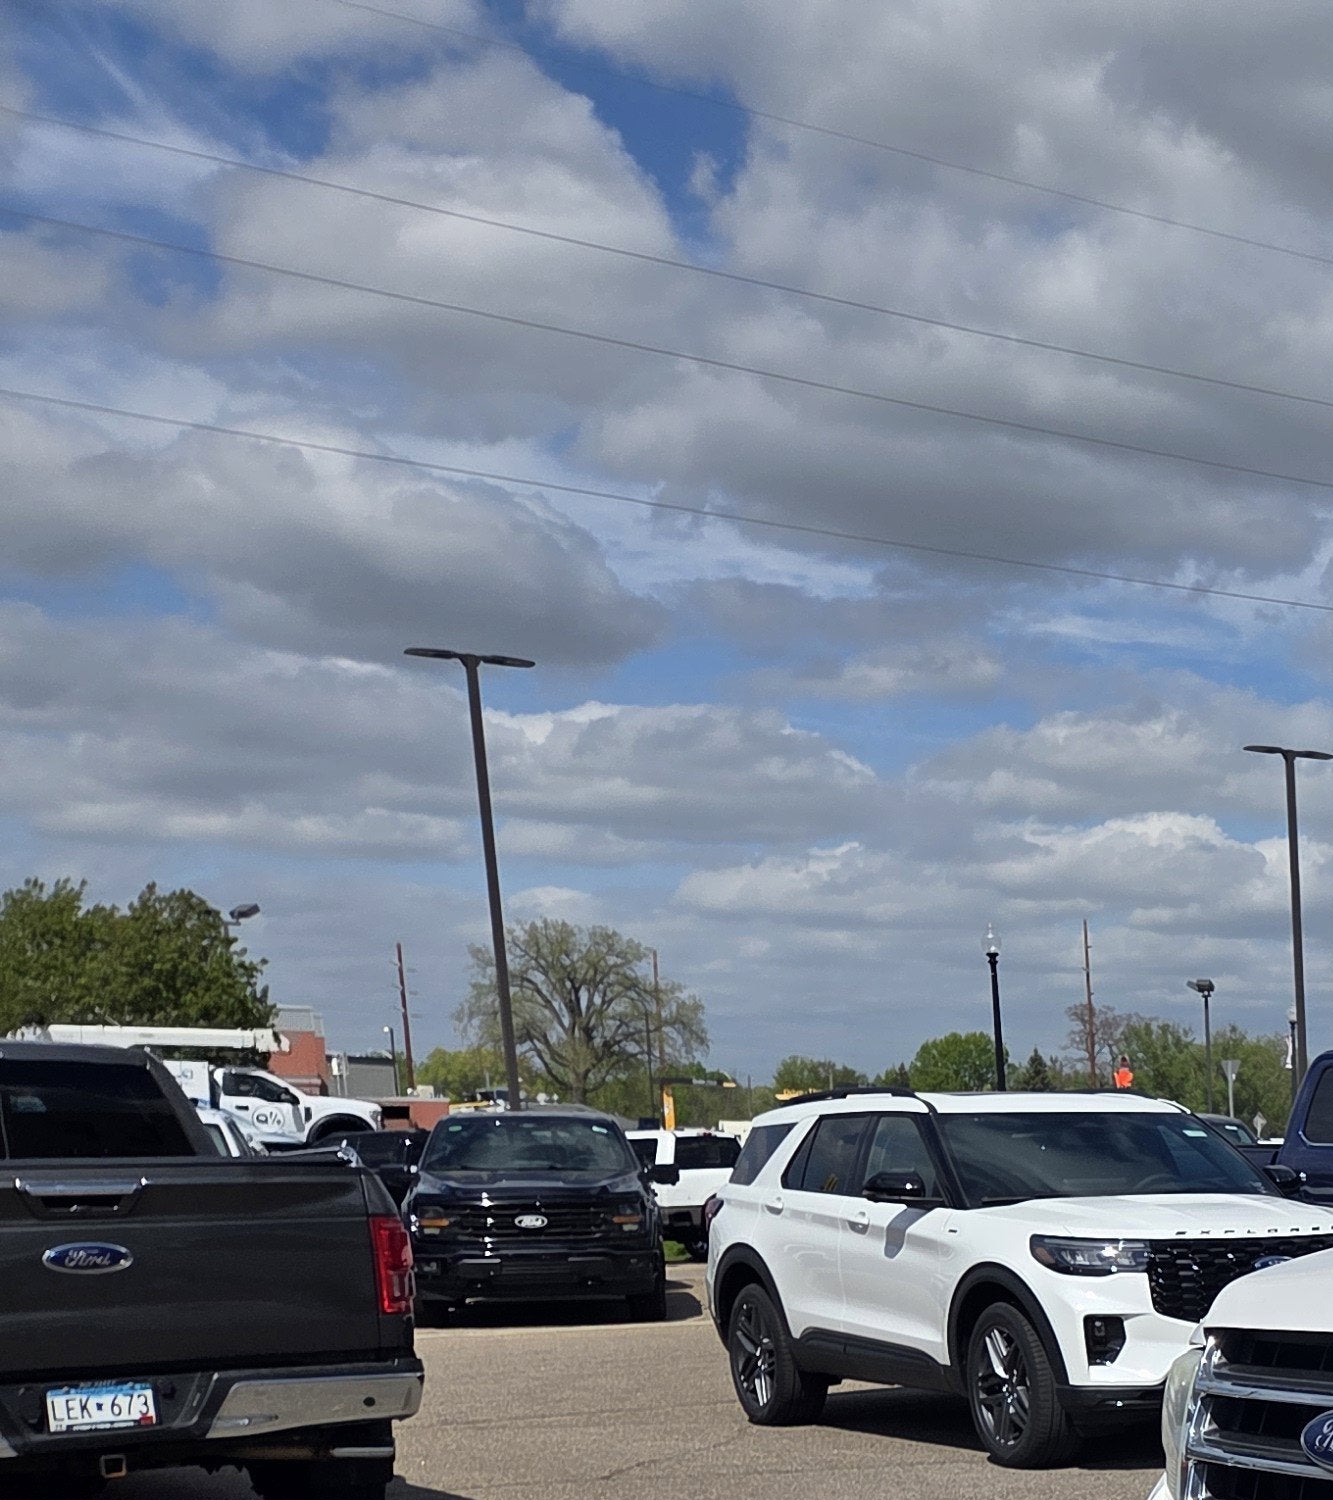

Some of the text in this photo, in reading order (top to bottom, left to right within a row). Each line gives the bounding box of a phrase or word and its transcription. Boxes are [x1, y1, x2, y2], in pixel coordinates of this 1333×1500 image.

[64, 1249, 111, 1267] Ford
[51, 1393, 149, 1421] LEK 673
